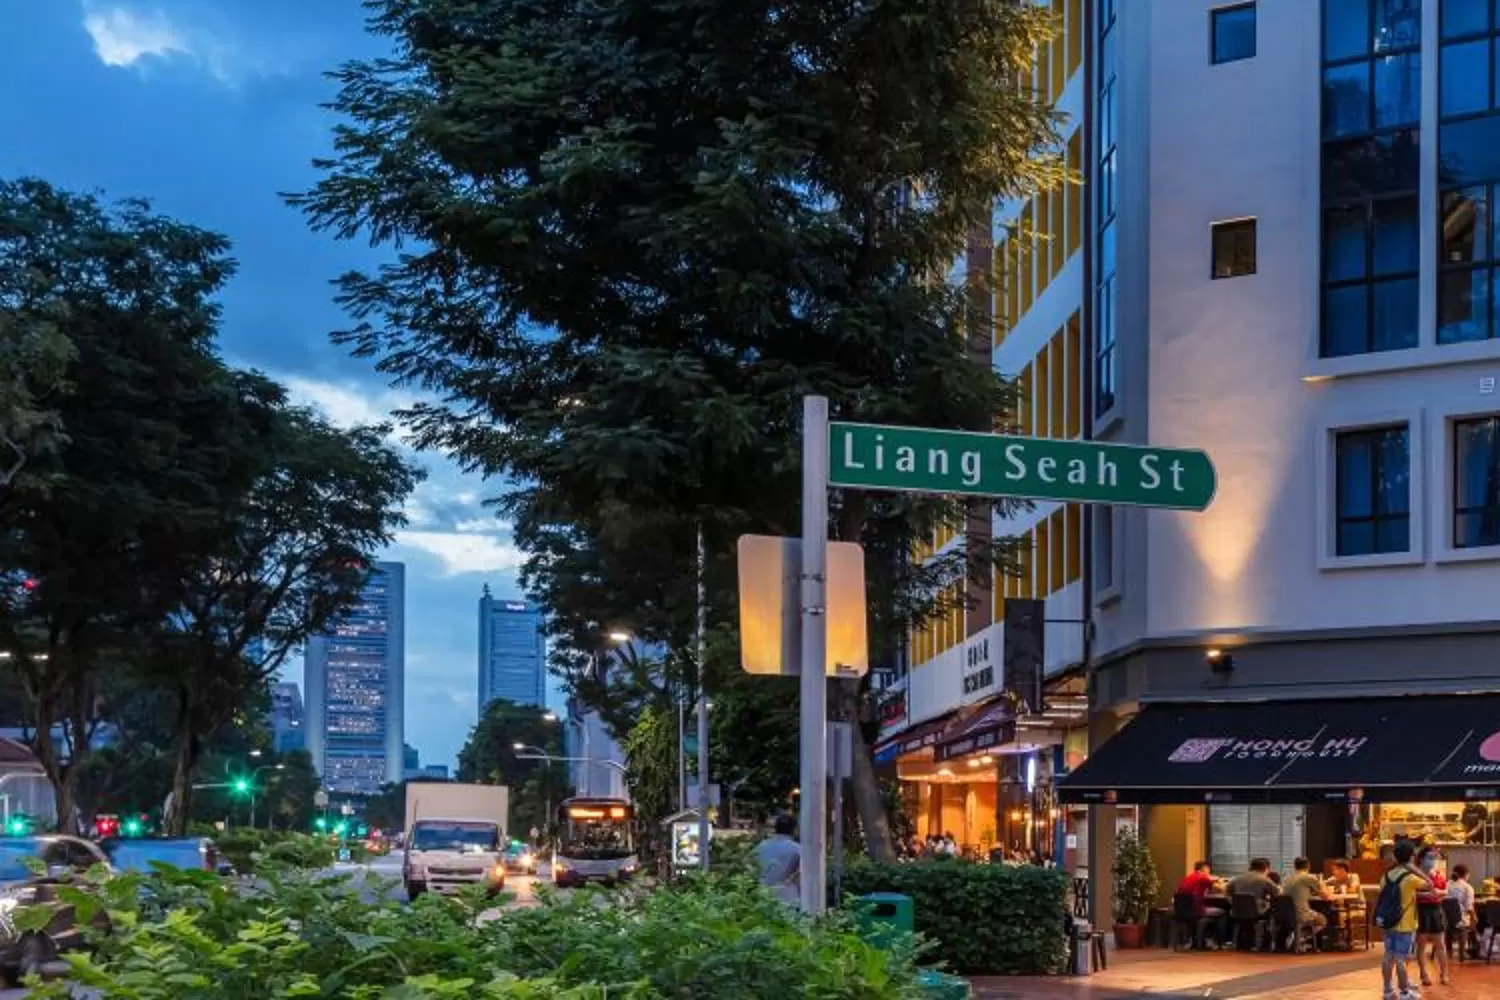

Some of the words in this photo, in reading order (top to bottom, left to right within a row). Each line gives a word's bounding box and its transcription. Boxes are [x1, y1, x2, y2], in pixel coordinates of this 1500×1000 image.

[843, 431, 982, 486] Liang
[1004, 444, 1118, 487] Seah
[1140, 454, 1185, 492] St
[1231, 738, 1315, 751] HONG
